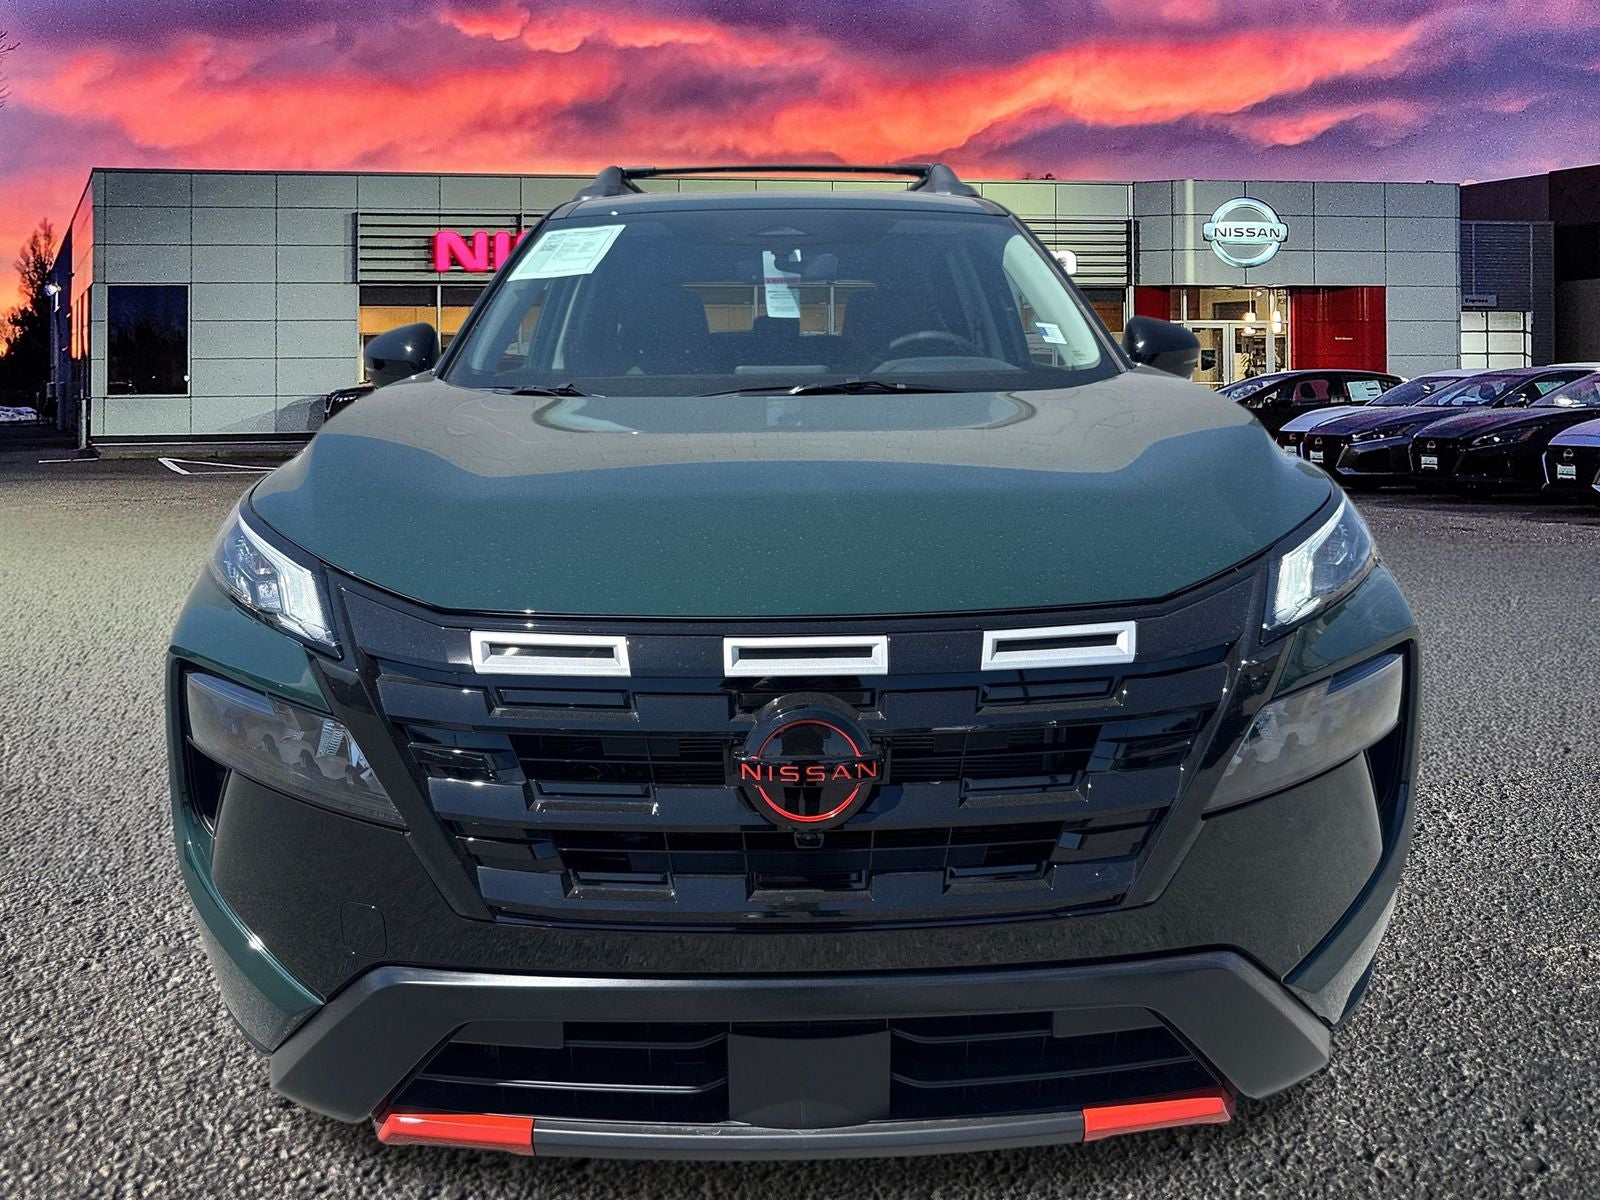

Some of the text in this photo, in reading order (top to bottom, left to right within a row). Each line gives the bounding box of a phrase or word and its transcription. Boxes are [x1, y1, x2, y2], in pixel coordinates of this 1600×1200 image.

[1214, 227, 1280, 238] NISSAN
[433, 230, 529, 272] NI
[740, 761, 878, 782] NISSAN
